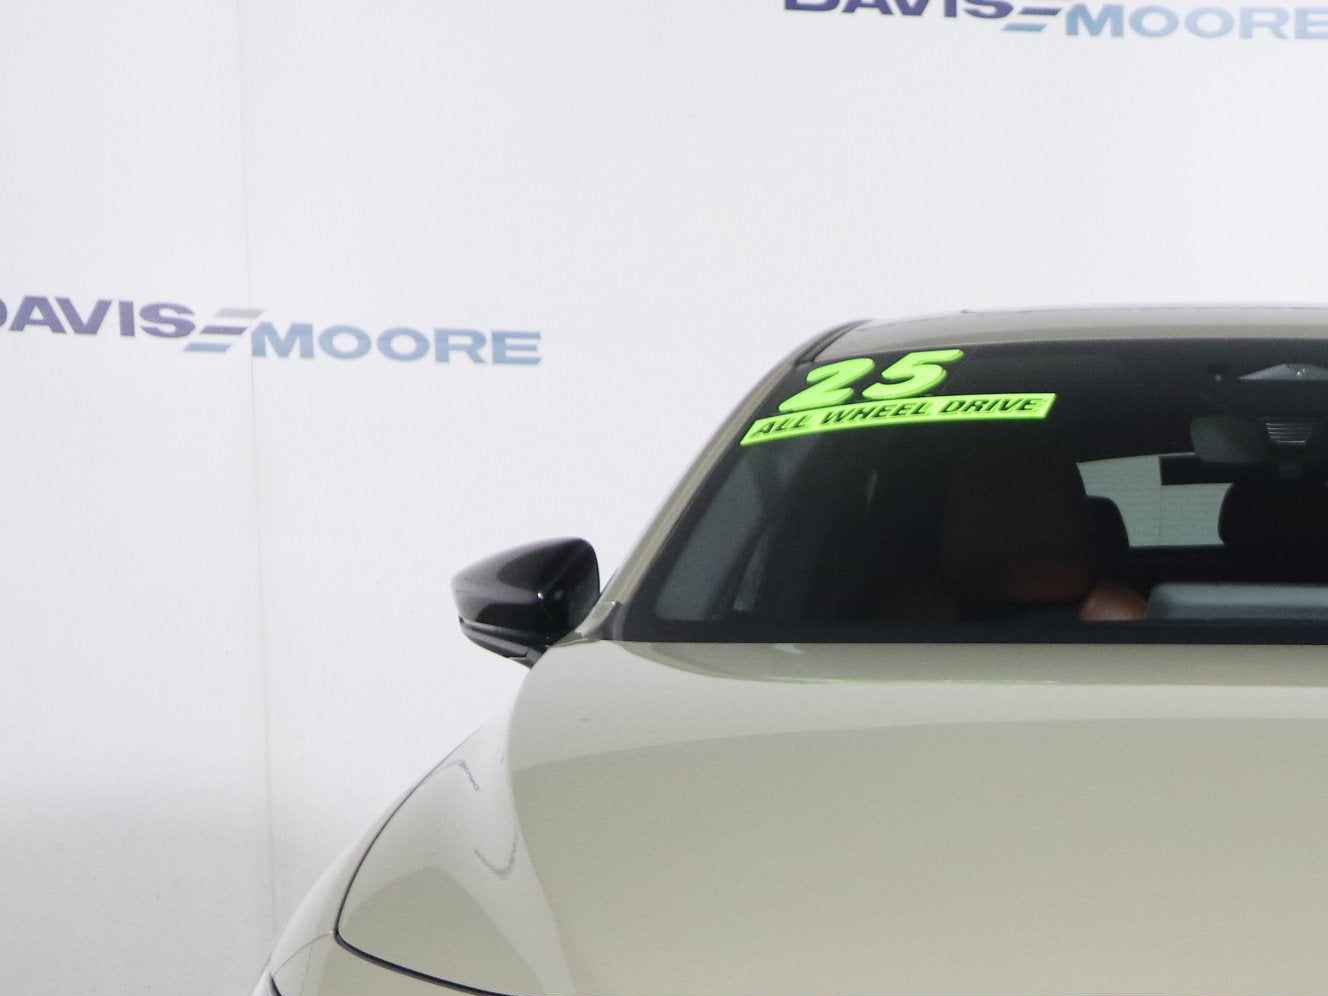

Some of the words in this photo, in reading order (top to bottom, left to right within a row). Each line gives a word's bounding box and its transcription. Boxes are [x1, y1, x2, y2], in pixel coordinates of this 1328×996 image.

[0, 296, 196, 338] AVIS
[252, 321, 542, 365] MOORE
[778, 349, 964, 414] 25
[754, 414, 807, 436] ALL
[821, 401, 928, 424] WHEEL
[941, 397, 1037, 413] DRIVE
